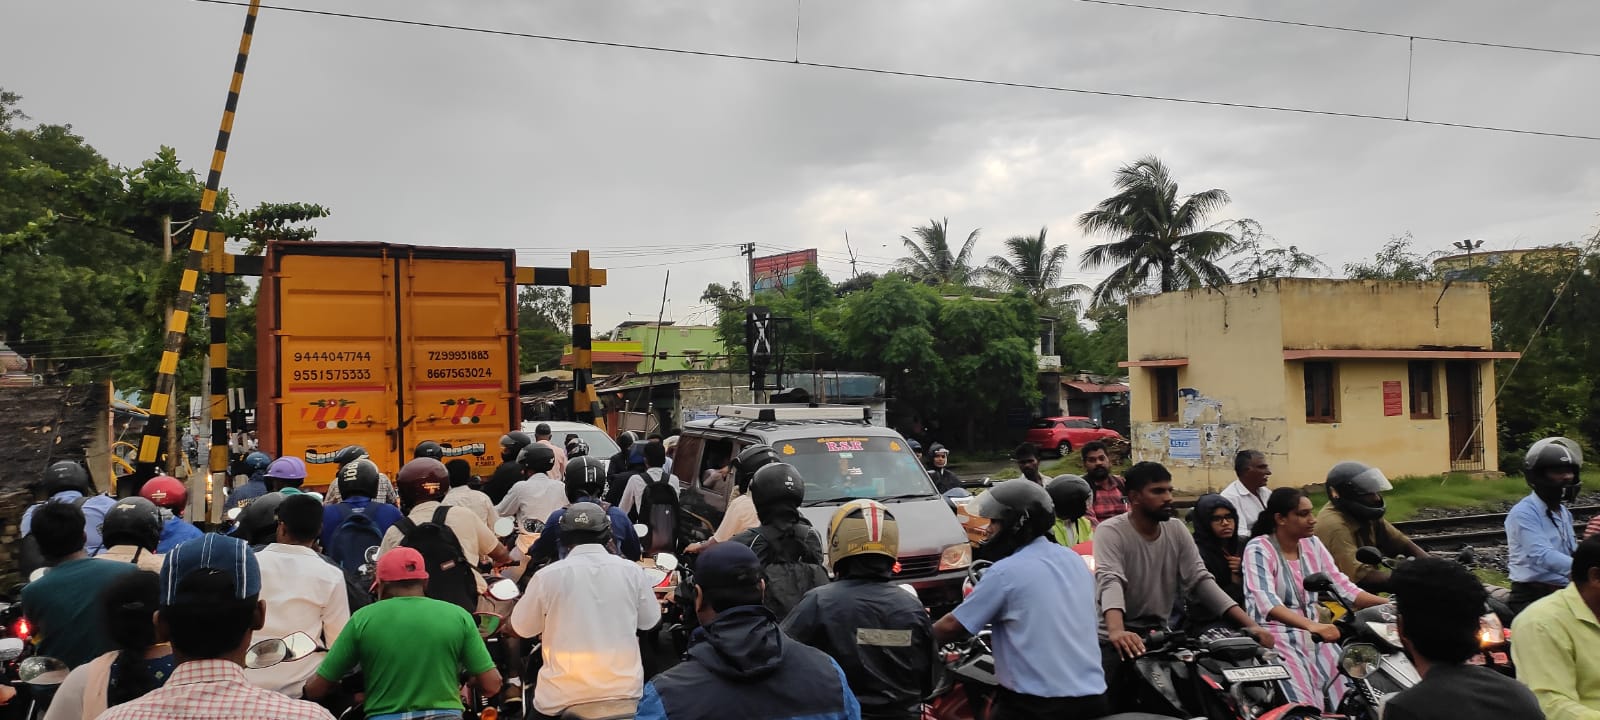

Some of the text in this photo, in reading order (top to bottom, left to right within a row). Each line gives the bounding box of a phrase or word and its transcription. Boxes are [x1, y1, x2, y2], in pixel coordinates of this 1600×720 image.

[294, 351, 371, 362] 9444047744
[428, 350, 489, 361] 7299931883
[293, 368, 371, 381] 9551575333
[427, 367, 492, 379] 8667563024
[305, 448, 341, 464] SOU
